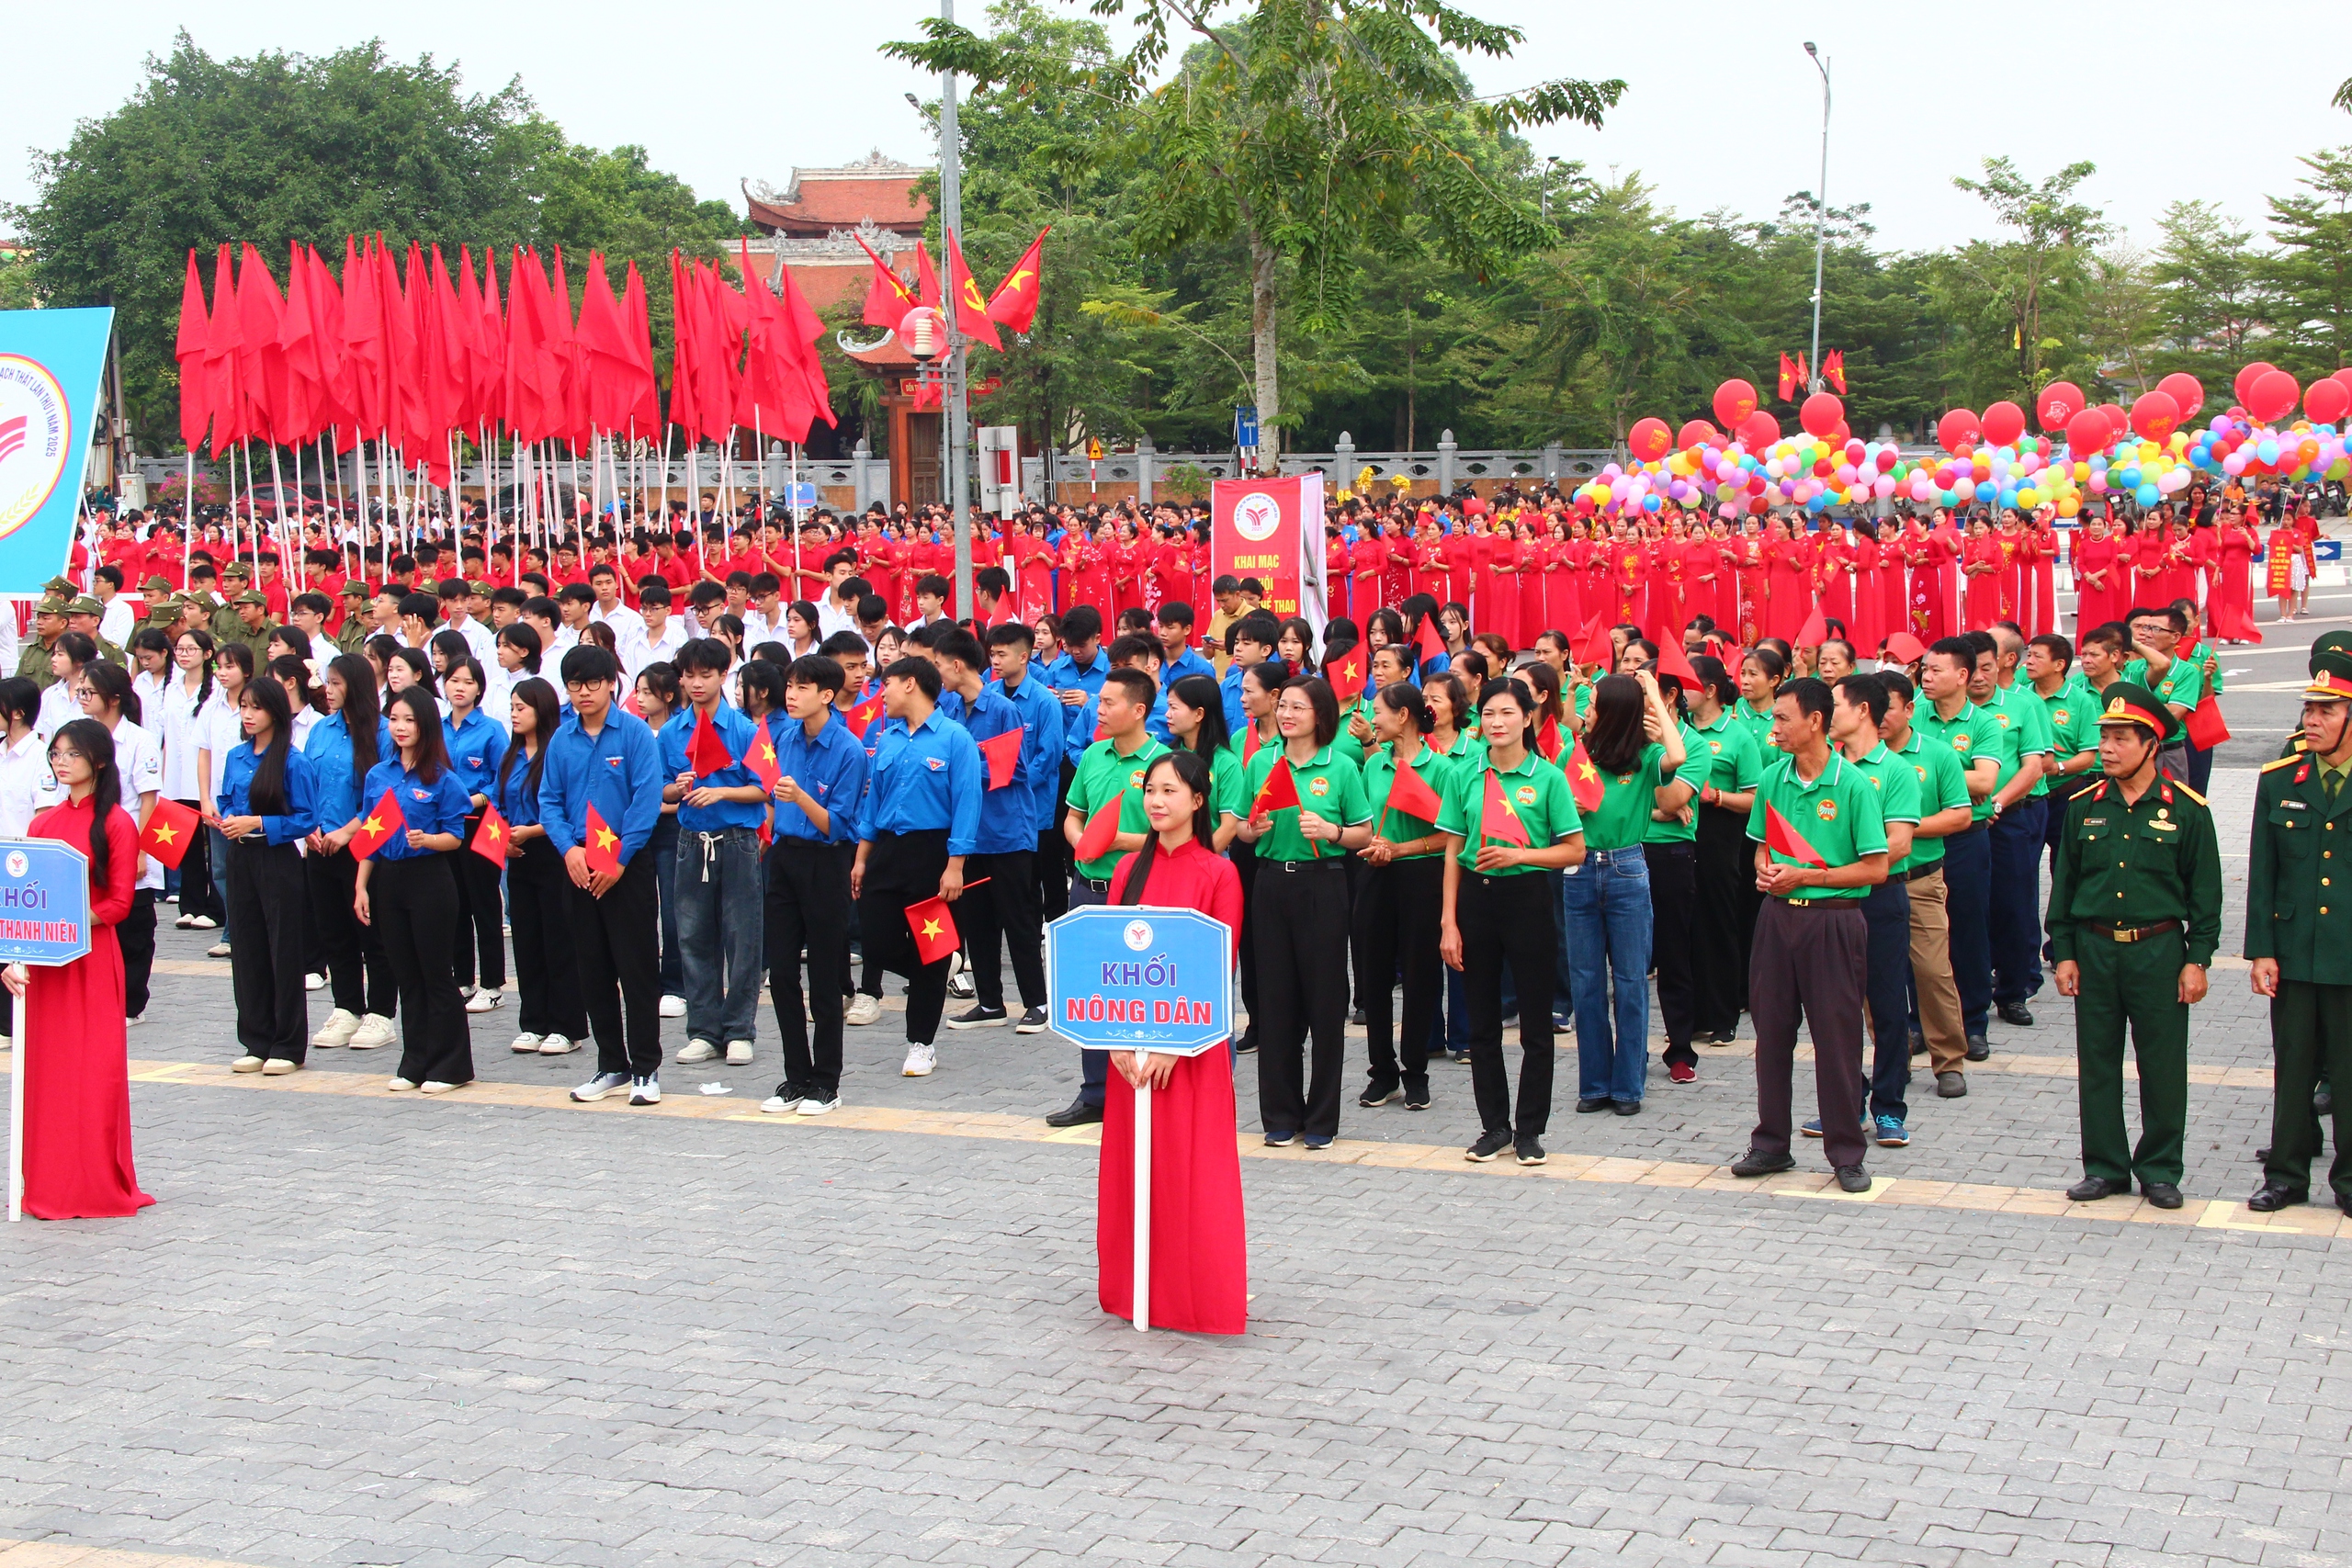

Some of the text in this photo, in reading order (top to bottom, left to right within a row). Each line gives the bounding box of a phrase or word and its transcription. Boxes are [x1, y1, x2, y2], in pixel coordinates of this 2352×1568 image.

[46, 412, 61, 435] NĂM
[45, 436, 59, 457] 2025
[1234, 554, 1280, 571] KHAI MẠC
[1259, 594, 1296, 614] HỂ THAO
[0, 879, 48, 909] HỐI
[0, 919, 78, 943] THANH NIÊN
[1102, 953, 1177, 987] KHỐI
[1067, 994, 1213, 1025] NÔNG DÂN
